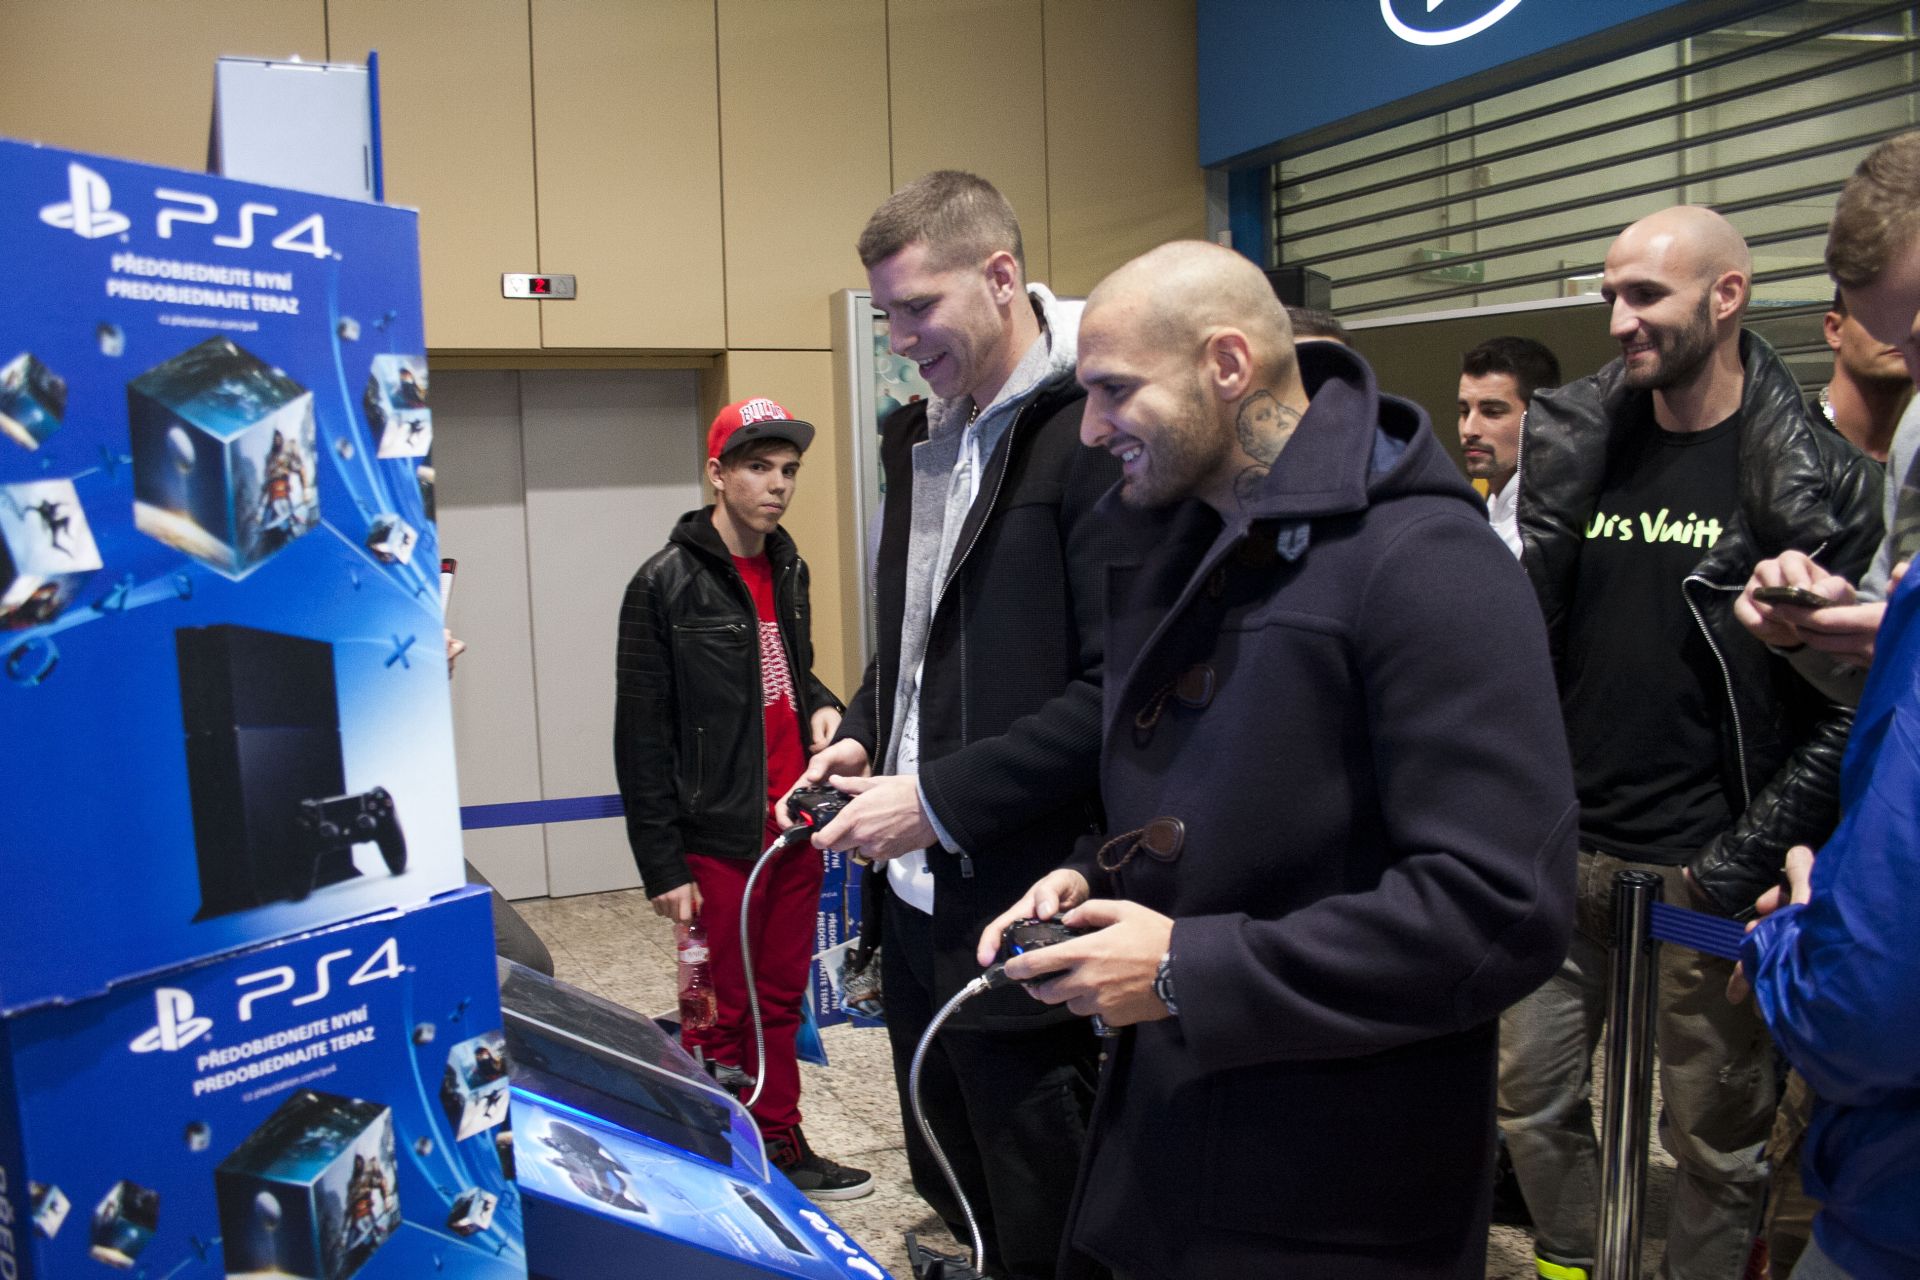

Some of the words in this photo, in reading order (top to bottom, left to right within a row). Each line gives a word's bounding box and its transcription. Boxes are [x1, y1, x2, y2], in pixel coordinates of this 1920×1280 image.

[155, 187, 332, 259] PS4
[106, 278, 250, 310] PREDOBJEDNAJTE
[251, 293, 299, 315] TERAZ
[111, 252, 250, 287] PŘEDOBJEDNEJTE
[253, 270, 292, 291] NYNÍ
[534, 277, 545, 293] 2
[236, 937, 405, 1021] PS4
[193, 1041, 329, 1096] PREDOBJEDNAJTE
[329, 1026, 375, 1052] TERAZ
[197, 1018, 330, 1072] PŘEDOBJEDNEJTE
[331, 1003, 368, 1030] NYNÍ
